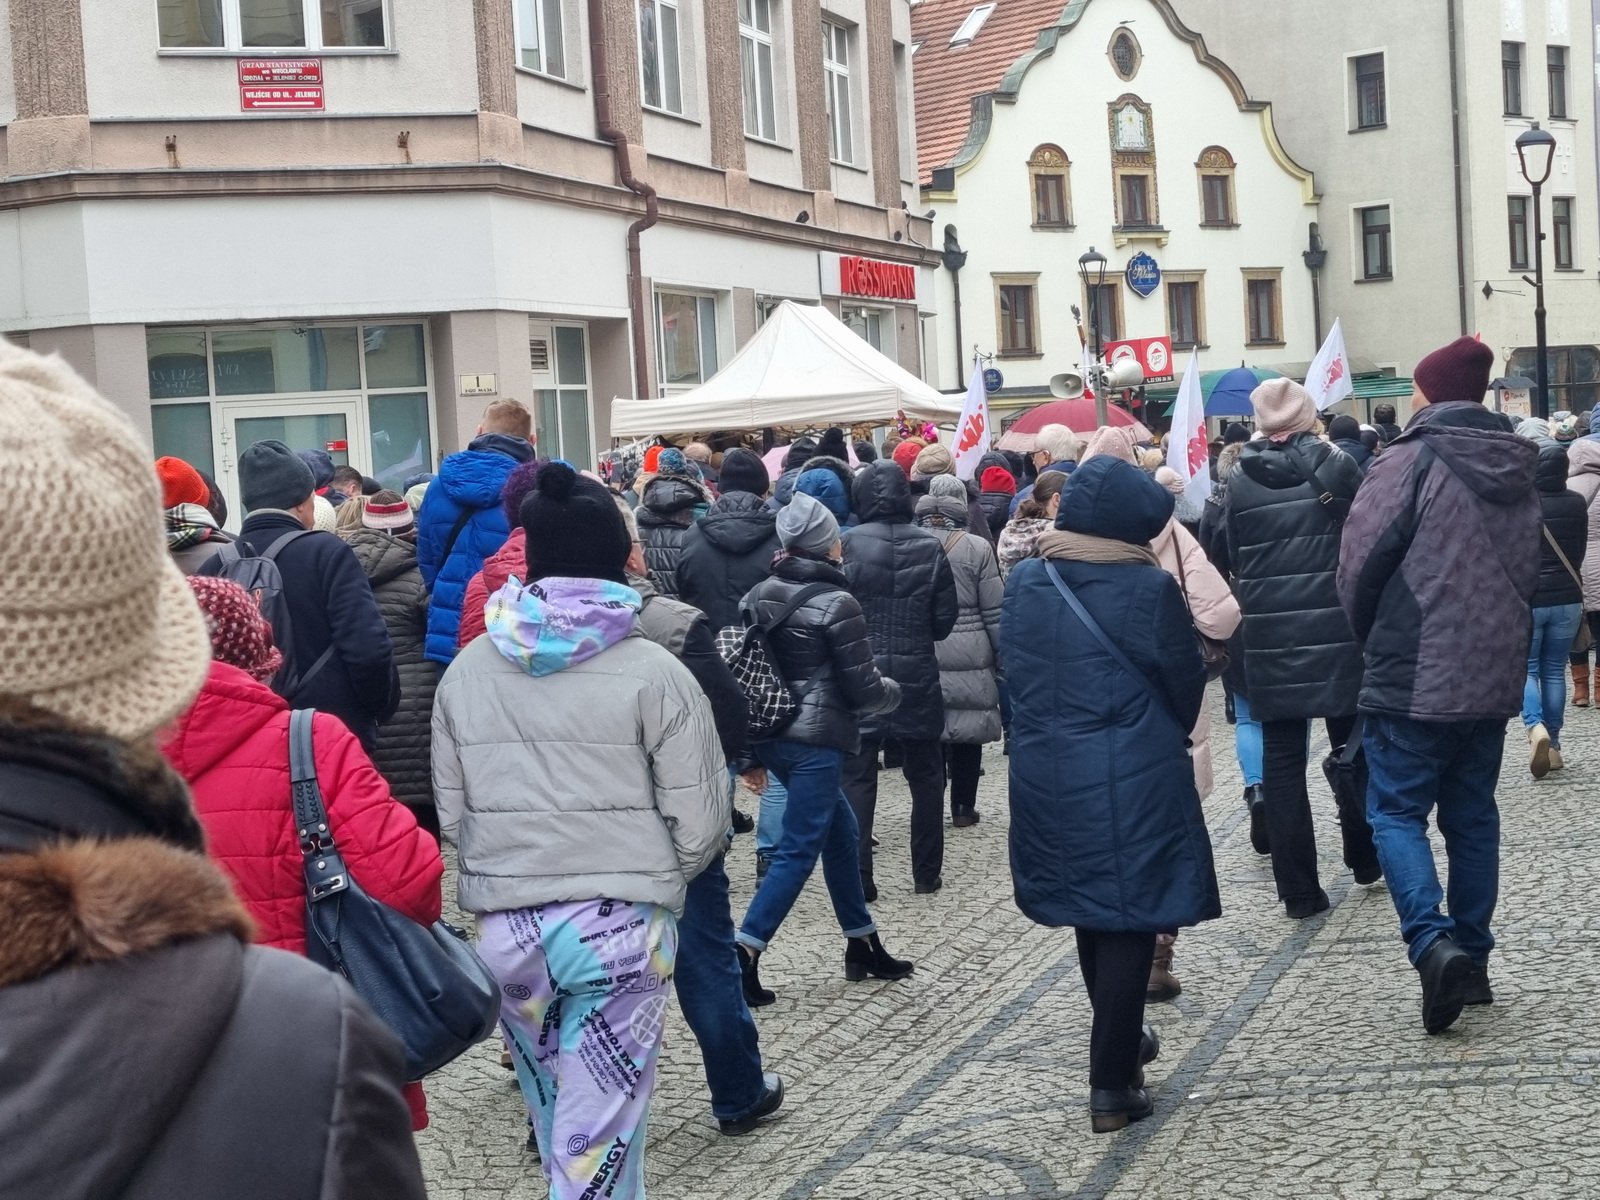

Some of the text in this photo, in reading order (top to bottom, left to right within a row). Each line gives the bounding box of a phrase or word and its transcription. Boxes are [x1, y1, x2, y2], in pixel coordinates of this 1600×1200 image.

[245, 90, 271, 98] WEJŚCIE
[846, 256, 915, 299] ROSSMANN
[476, 376, 480, 388] 1
[610, 924, 628, 935] YOU
[596, 1034, 613, 1056] GOOD
[609, 1036, 623, 1053] TO
[619, 1050, 637, 1072] LIKE
[579, 1136, 626, 1200] ENERGY
